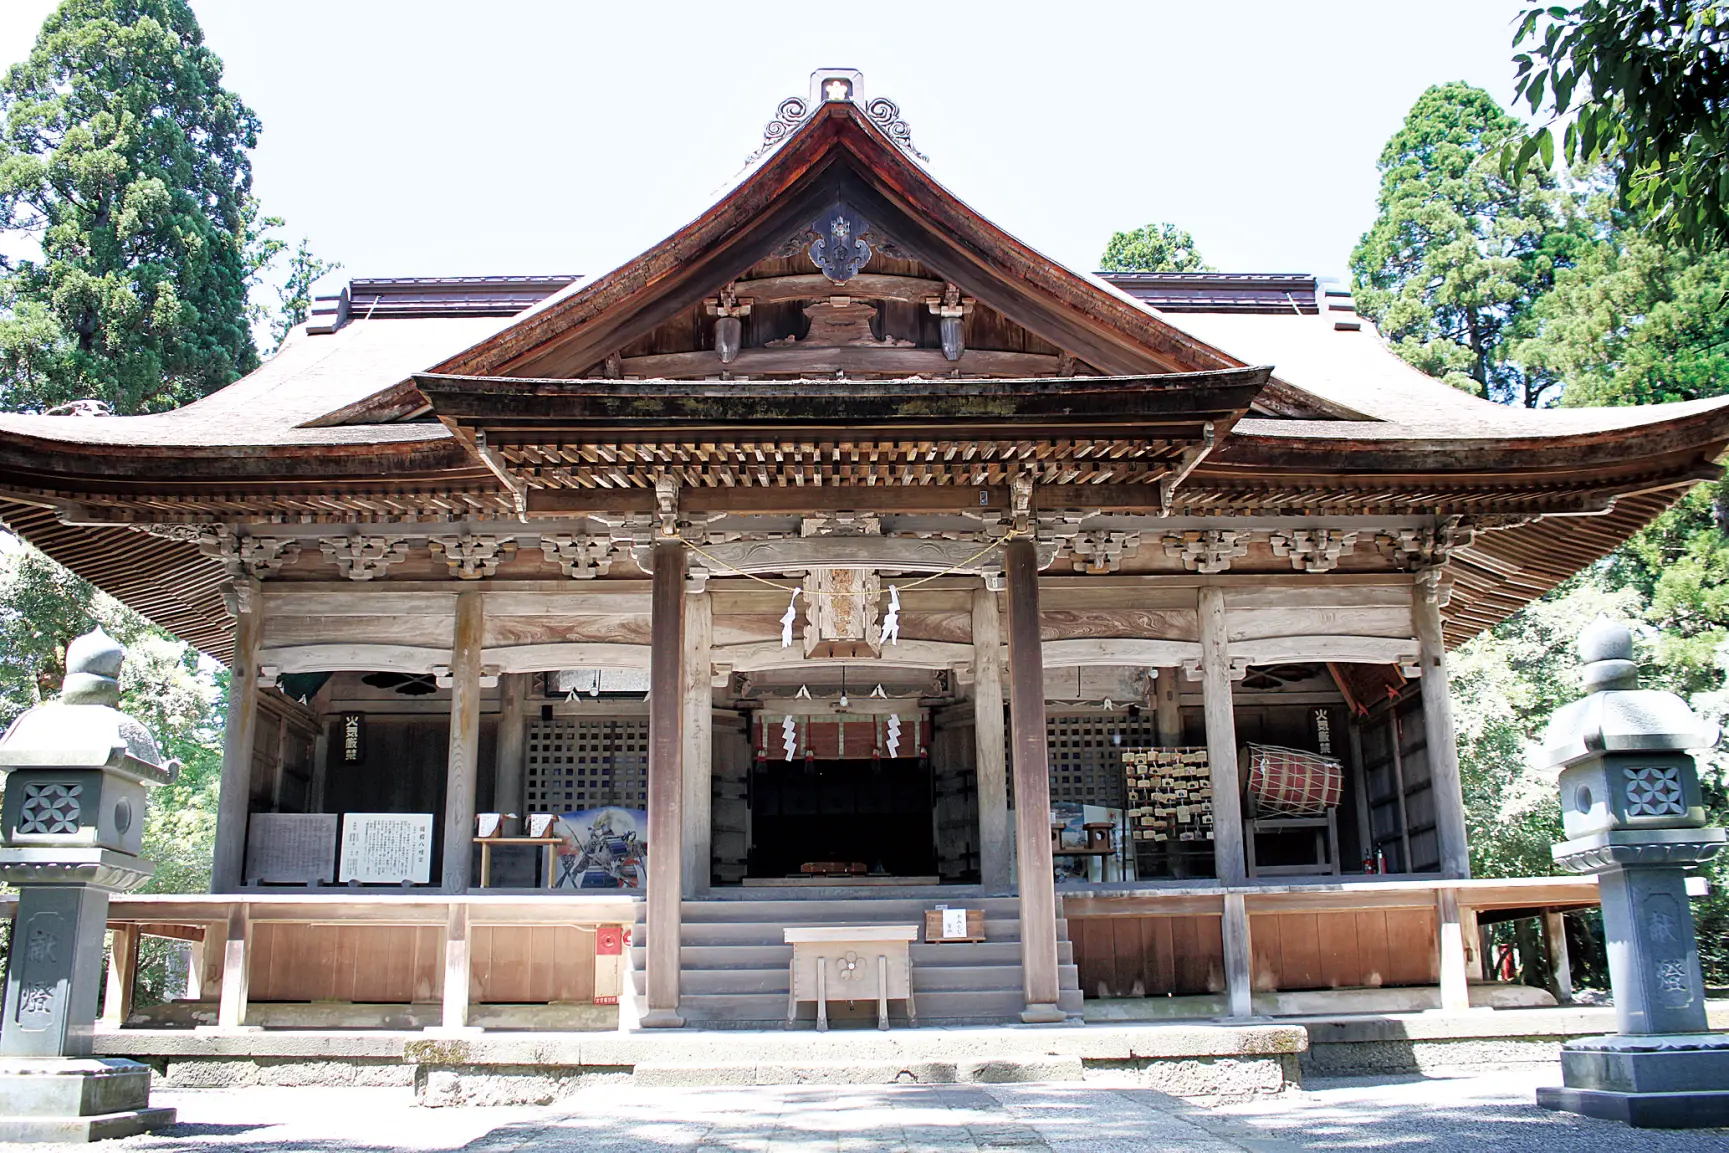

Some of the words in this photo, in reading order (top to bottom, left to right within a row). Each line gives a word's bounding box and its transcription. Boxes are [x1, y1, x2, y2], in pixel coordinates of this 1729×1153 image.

[345, 715, 358, 760] 火気厳禁
[1315, 709, 1331, 754] 火気厳禁
